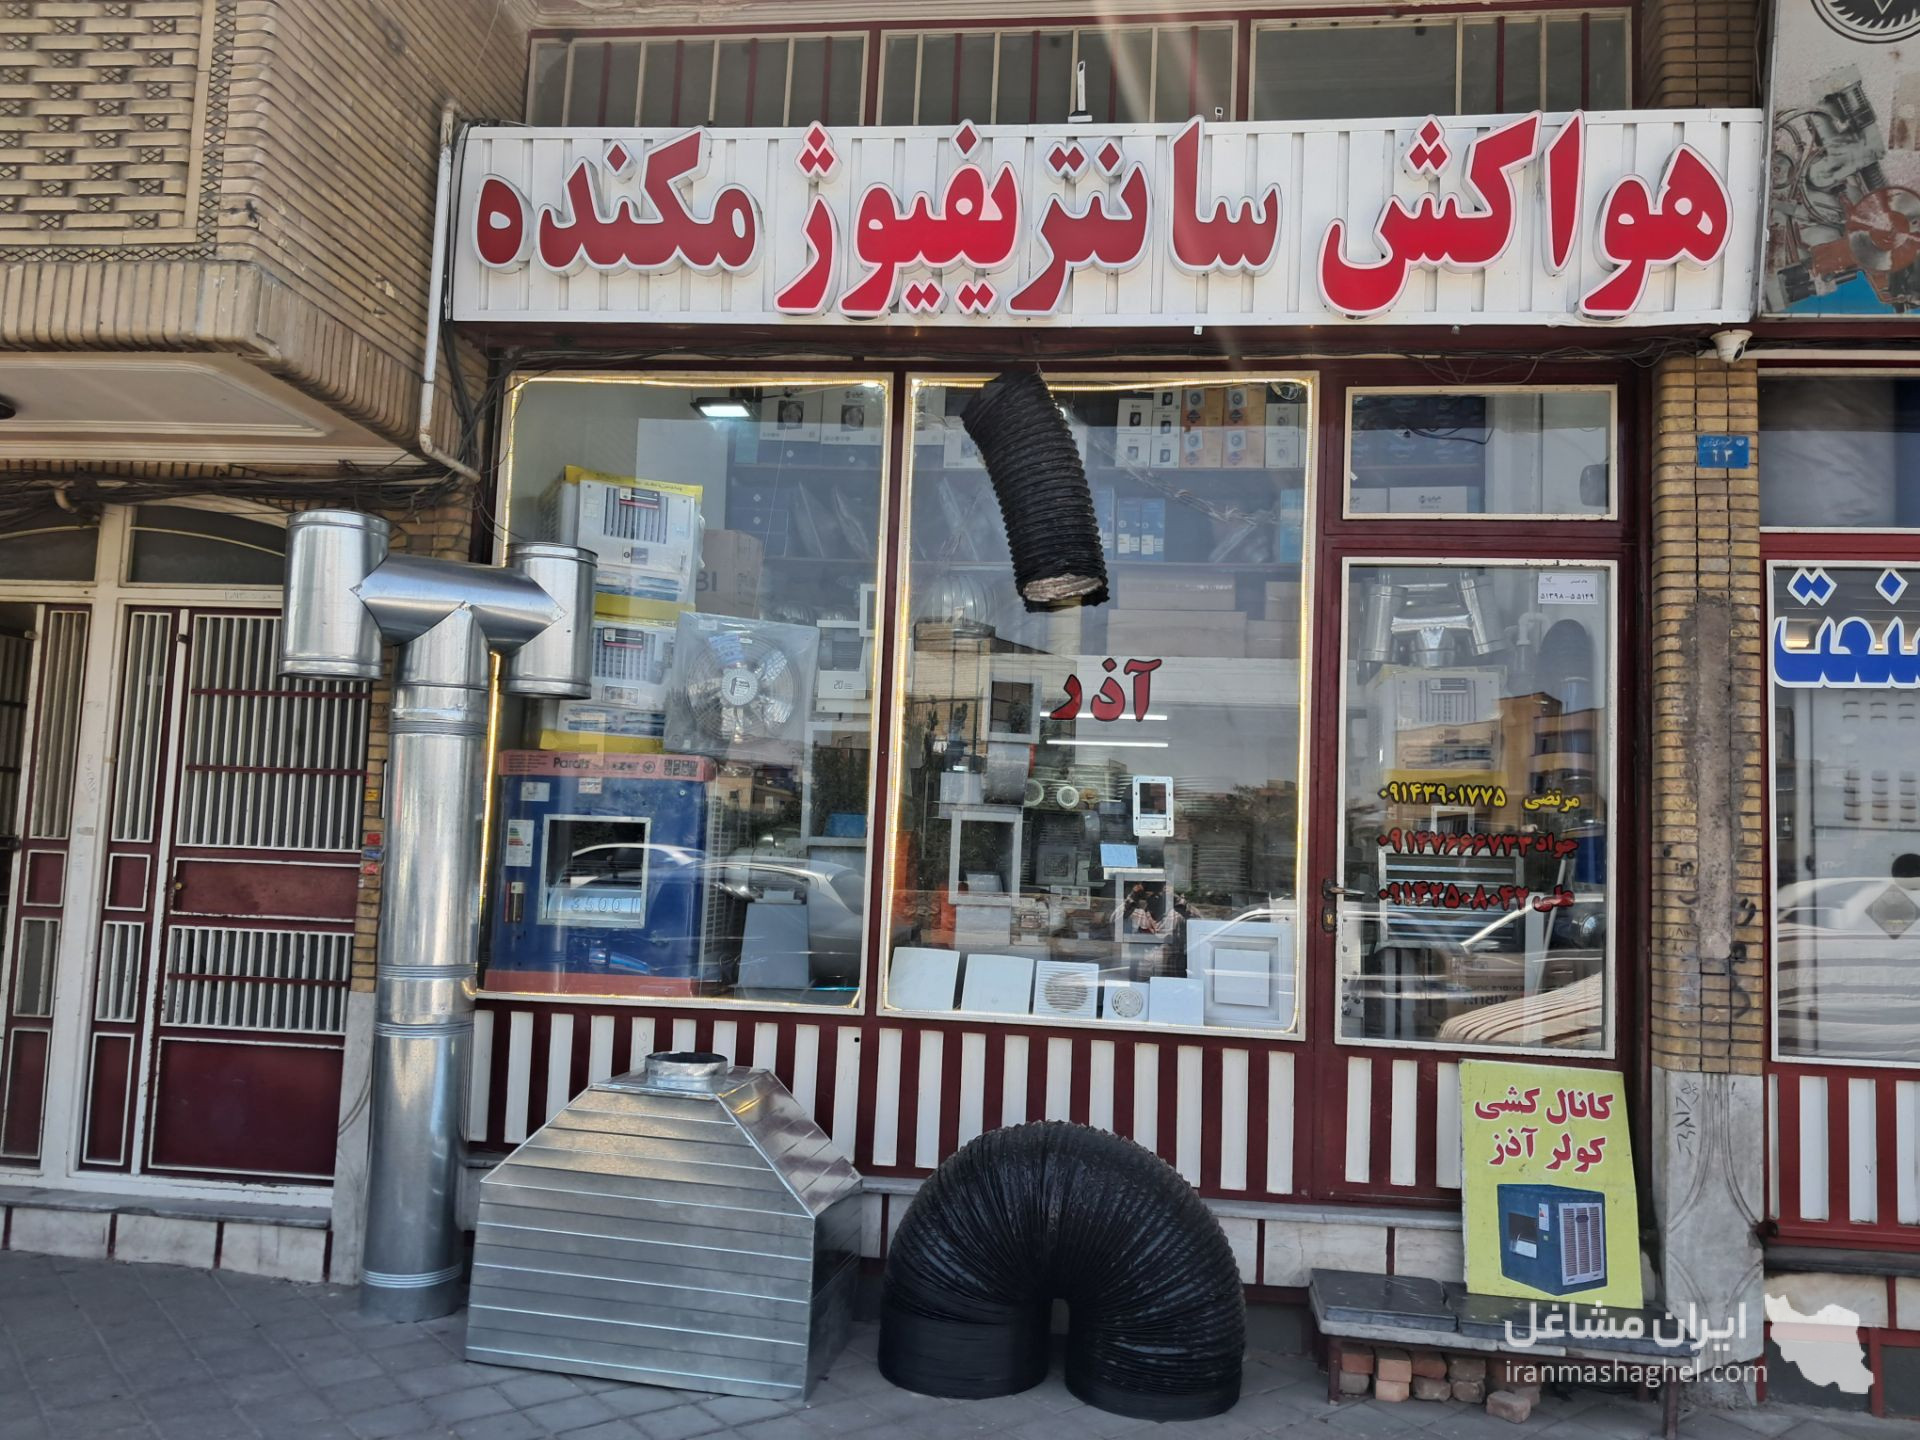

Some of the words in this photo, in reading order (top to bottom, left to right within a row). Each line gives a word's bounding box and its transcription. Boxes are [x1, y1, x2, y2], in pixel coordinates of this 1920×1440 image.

[476, 128, 760, 272] مکنده
[1320, 112, 1731, 315] هواکش
[1774, 568, 1920, 688] نعت
[1050, 657, 1163, 722] آذر
[1379, 781, 1507, 806] ۰۹۱۴۳۹۰۱۷۷۵
[1523, 789, 1580, 812] مرتضی
[1535, 833, 1579, 858] جواد
[1474, 1086, 1541, 1120] کشی
[1546, 1089, 1614, 1125] کانال
[1545, 1133, 1606, 1173] کولر
